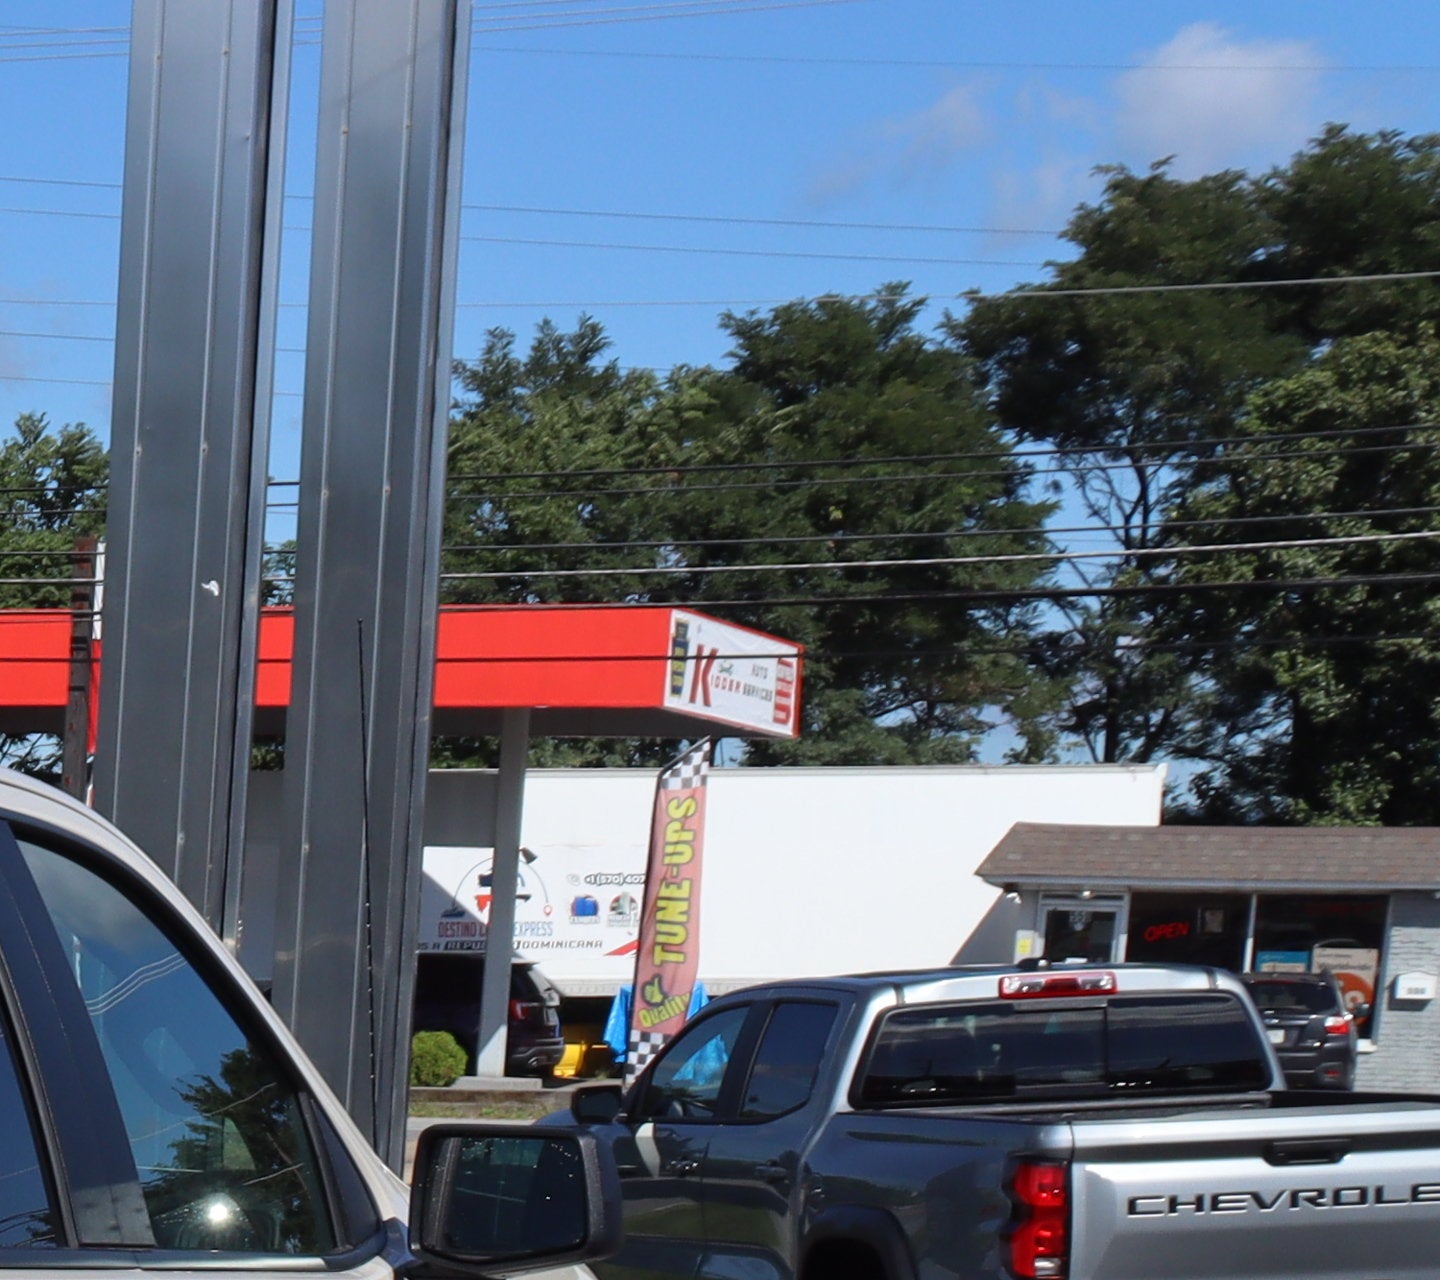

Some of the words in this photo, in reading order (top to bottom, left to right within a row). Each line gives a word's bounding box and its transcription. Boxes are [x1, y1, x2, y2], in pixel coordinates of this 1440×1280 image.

[653, 796, 698, 966] TUNE-UPS
[438, 921, 478, 937] DESTINO
[1144, 921, 1190, 942] OPEN
[522, 940, 603, 950] DOMINICANA
[638, 992, 692, 1028] Quality
[1127, 1183, 1440, 1218] CHEVROLE
